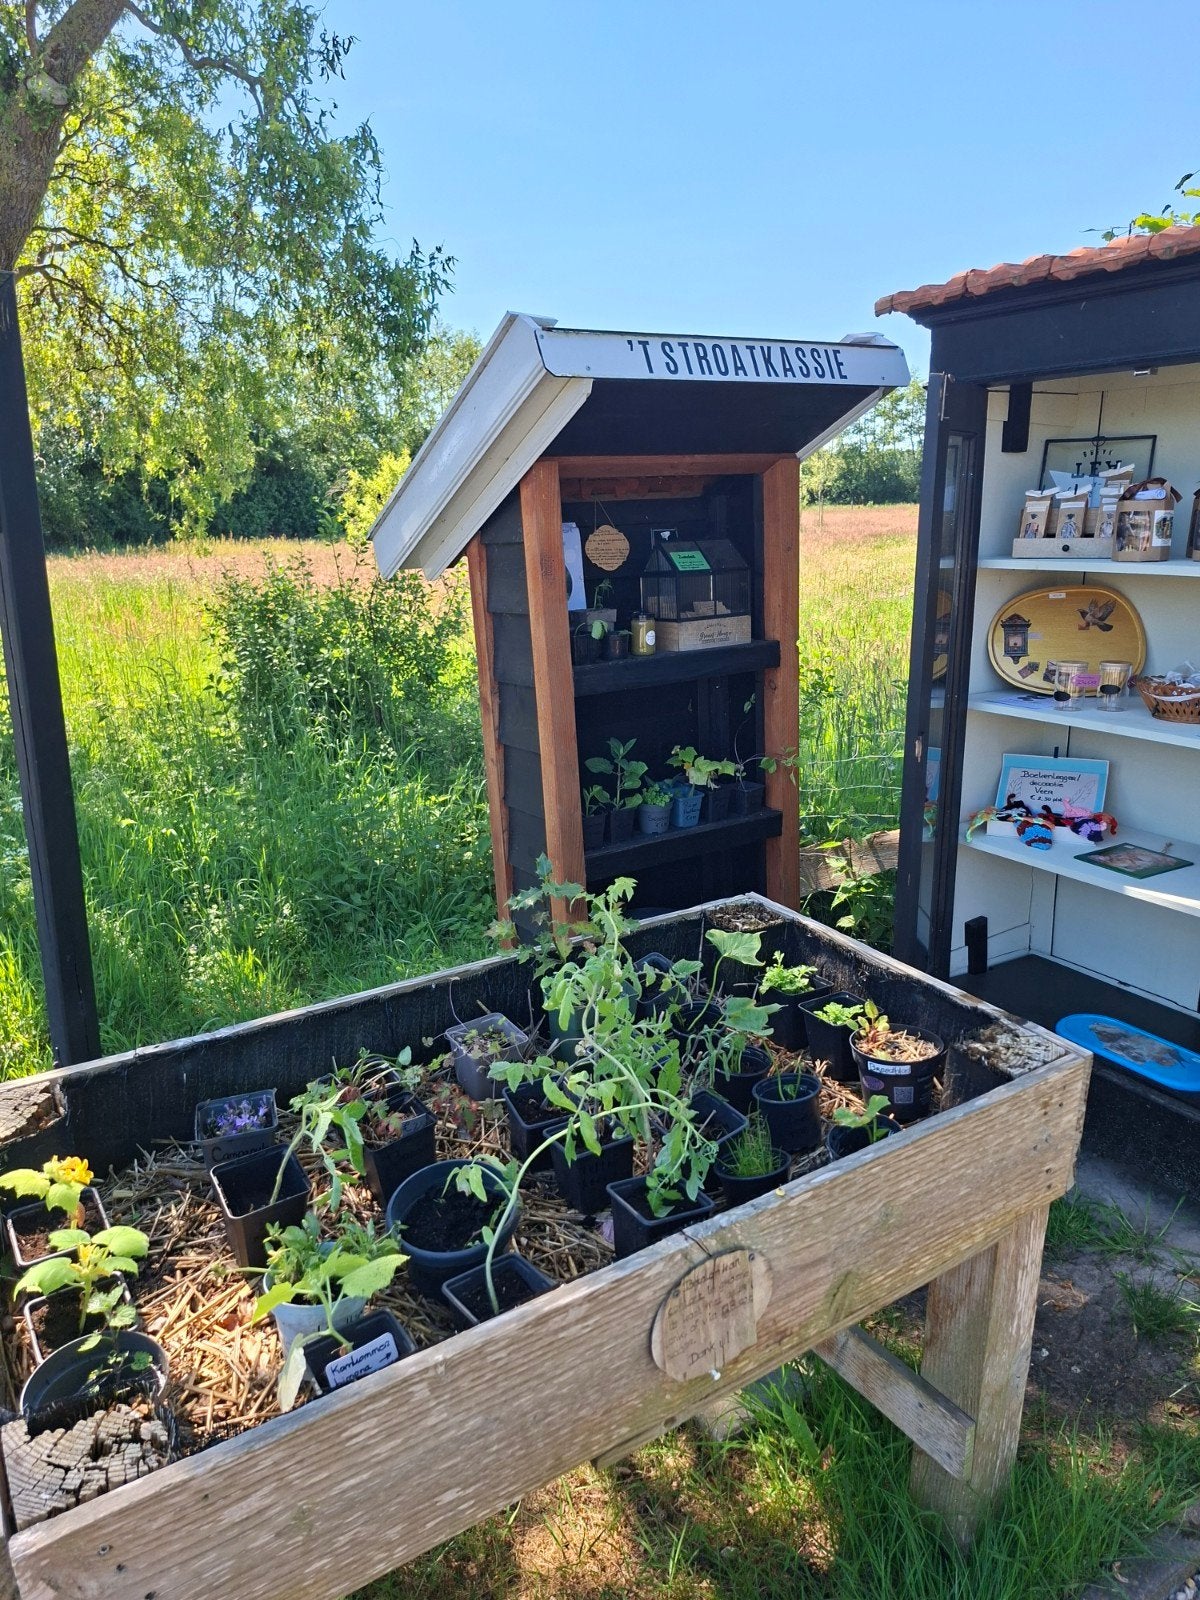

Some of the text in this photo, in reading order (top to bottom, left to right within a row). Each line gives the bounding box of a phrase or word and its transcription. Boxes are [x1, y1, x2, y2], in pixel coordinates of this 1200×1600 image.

[626, 339, 848, 380] 'T STROATKASSIE
[688, 1341, 715, 1367] Dank
